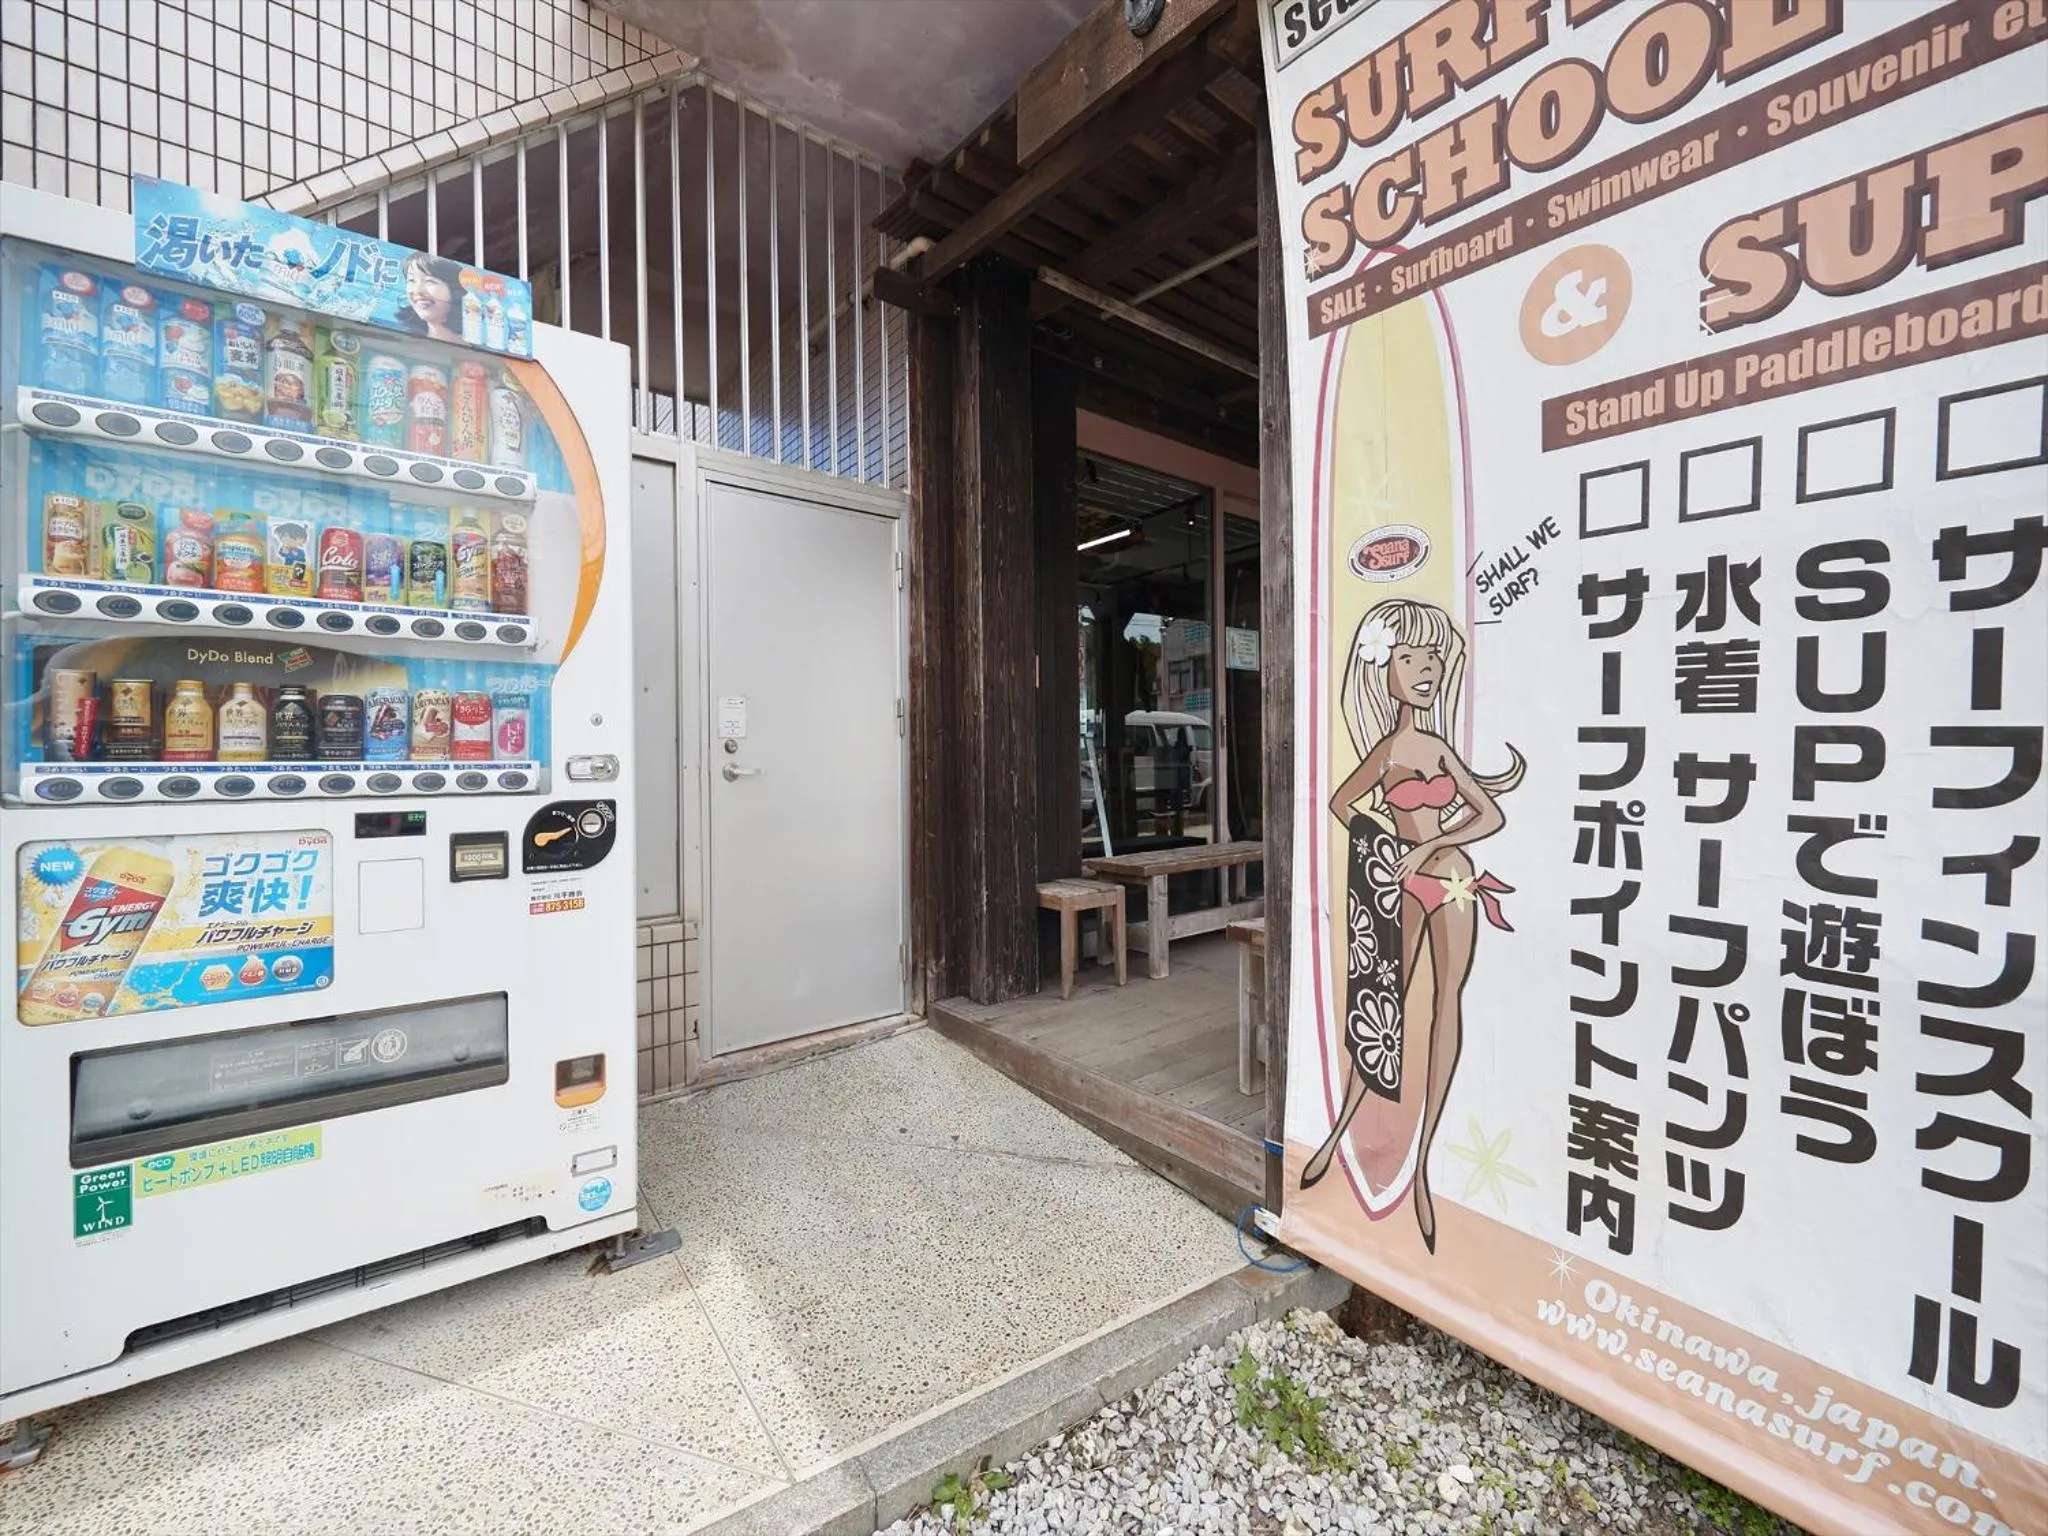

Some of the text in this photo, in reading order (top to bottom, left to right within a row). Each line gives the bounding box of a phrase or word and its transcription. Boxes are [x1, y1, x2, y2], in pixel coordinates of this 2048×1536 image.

[1302, 0, 1844, 283] SCHOOL
[1320, 283, 1366, 325] SALE
[1391, 215, 1514, 296] Surfboard
[1547, 128, 1721, 228] Swimwear
[1766, 19, 1971, 137] Souvenir
[1700, 107, 2048, 337] SUP
[1540, 269, 1608, 338] &
[1565, 274, 2048, 438] Stand Up Paddleboard
[321, 546, 360, 569] Cola
[1475, 515, 1562, 594] SHALL WE
[1488, 566, 1541, 616] SURF?
[187, 648, 230, 665] DyDo
[234, 651, 275, 665] Blend
[40, 861, 75, 872] NEW
[203, 850, 319, 878] ゴクゴク
[1780, 539, 1891, 1164] SUPで遊ぼう
[108, 901, 156, 915] ENERGY
[1565, 568, 1650, 1257] サーフポイント案内
[1665, 555, 1762, 1232] 水着 サーフパンツ
[196, 920, 317, 945] パワフルチャージ
[79, 1169, 127, 1185] Green
[79, 1177, 128, 1195] Power
[82, 1215, 126, 1234] WIND
